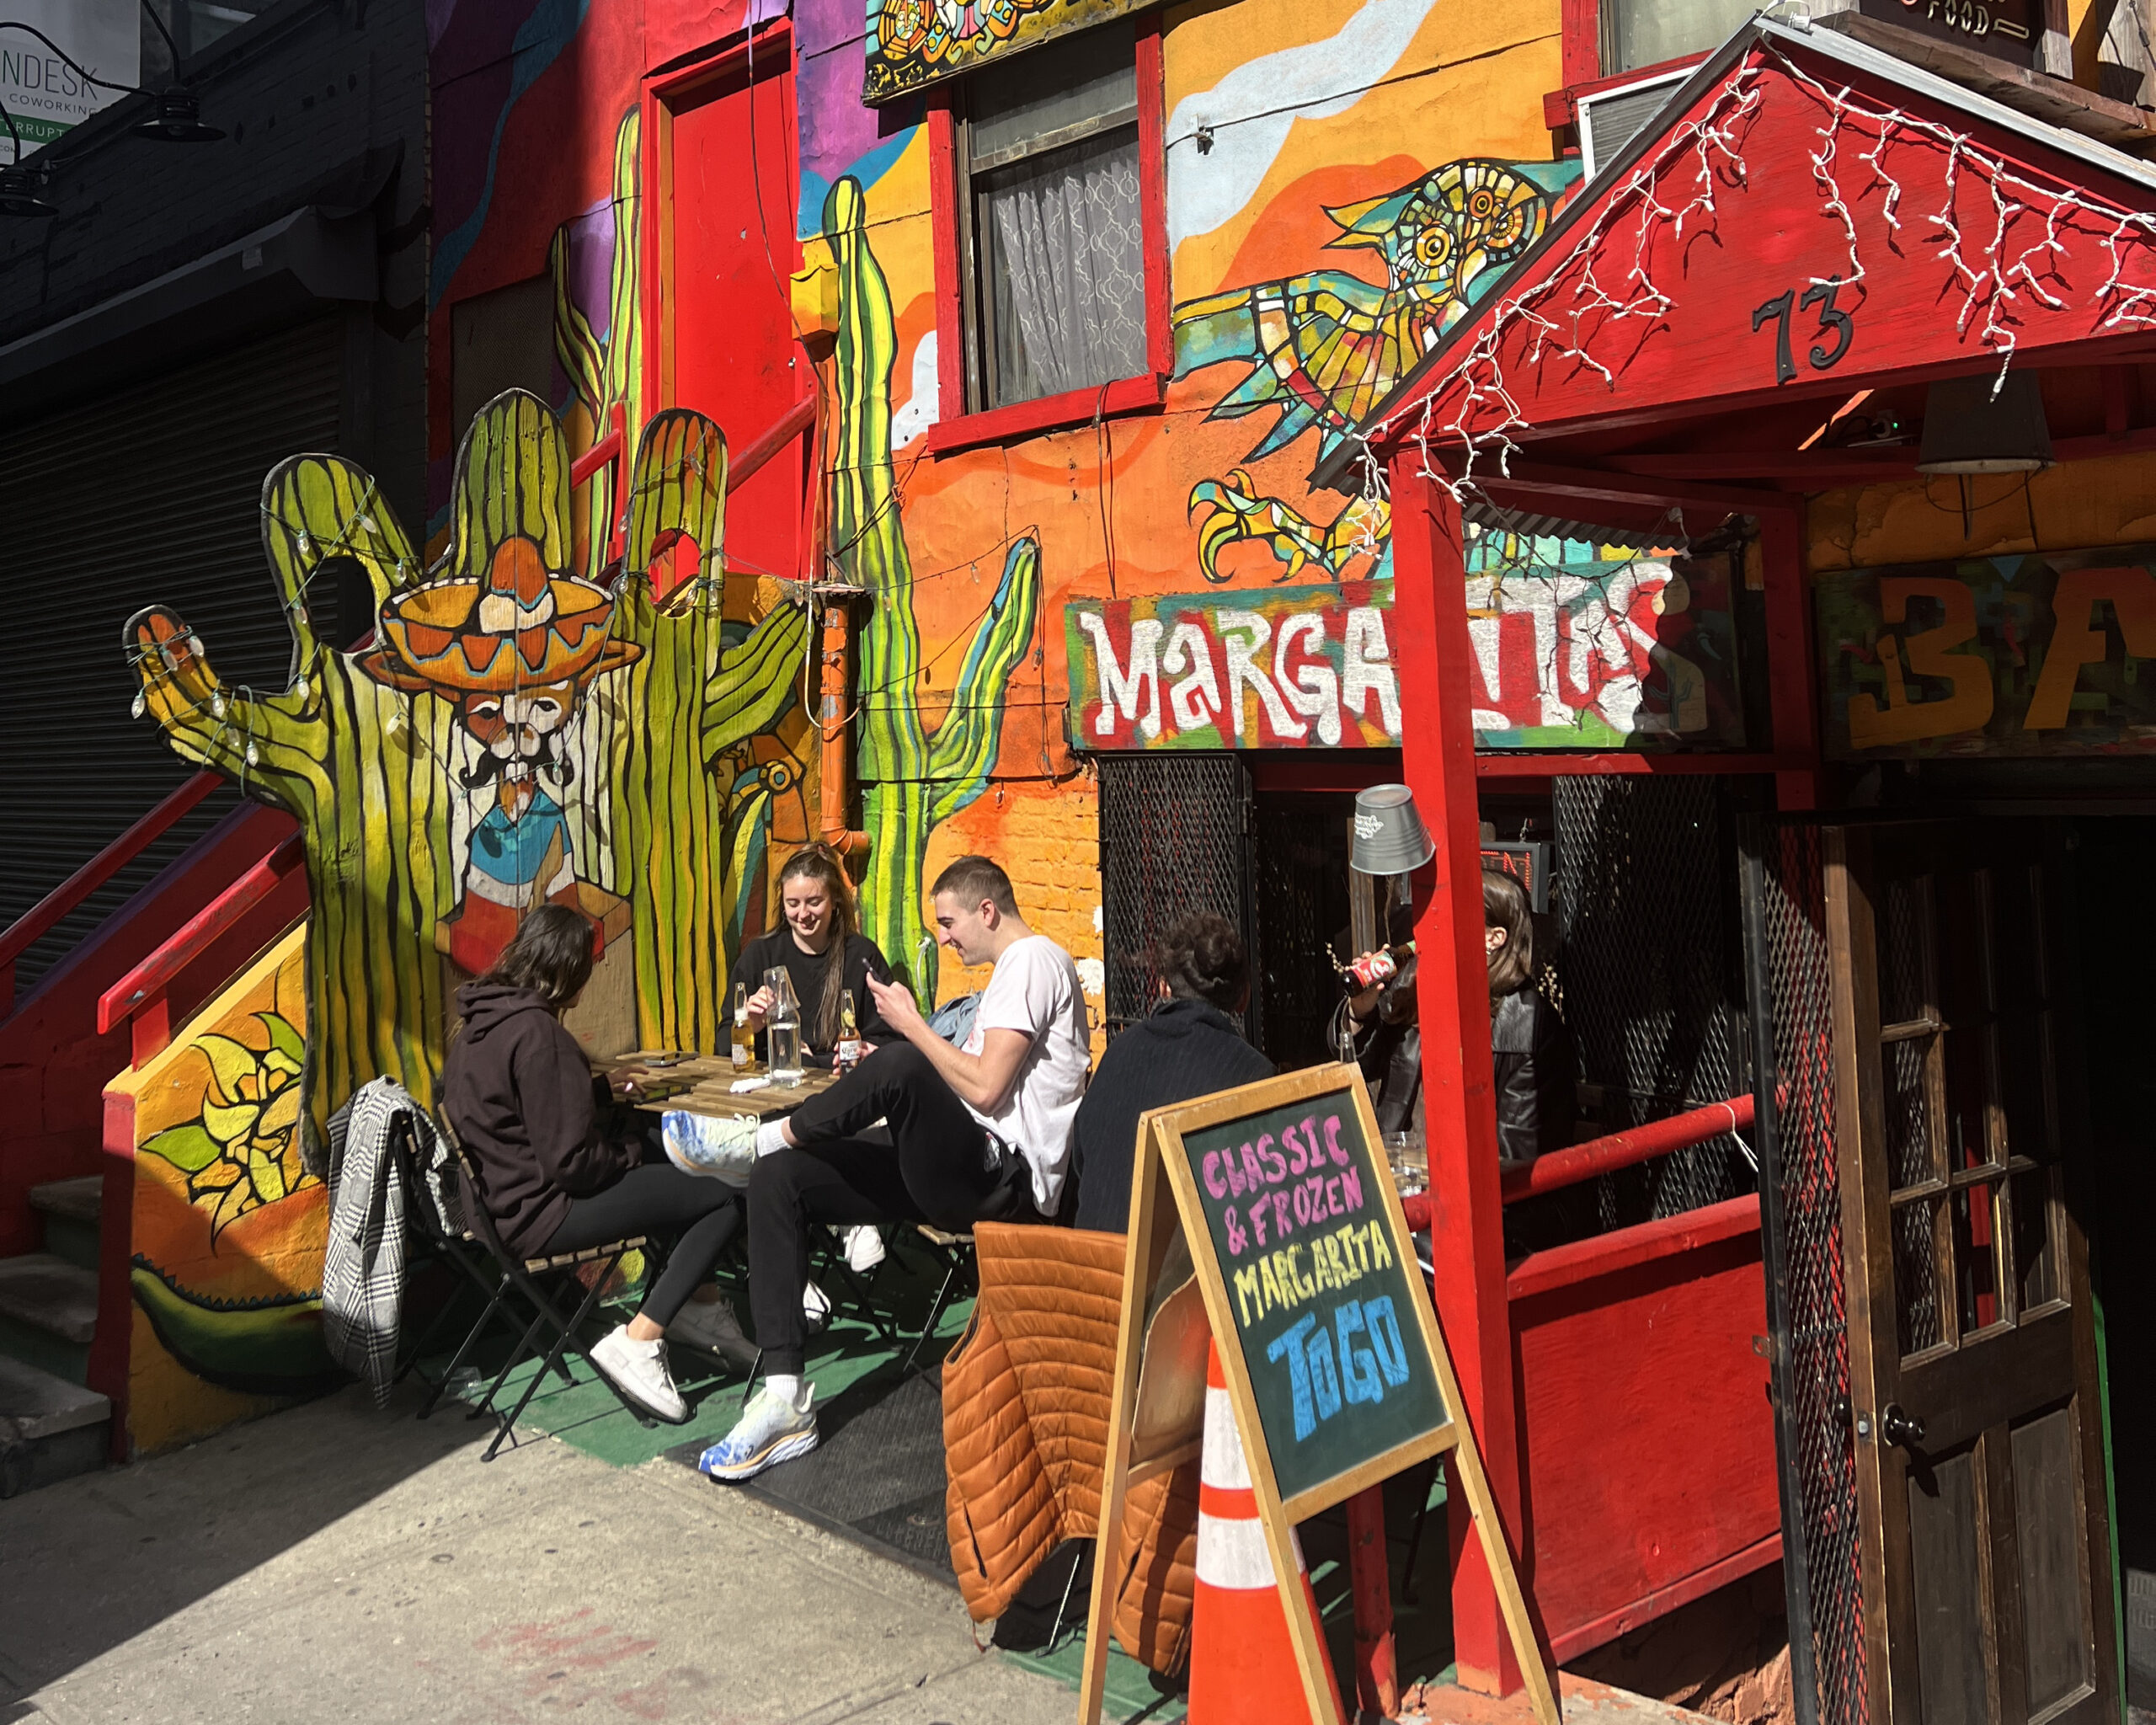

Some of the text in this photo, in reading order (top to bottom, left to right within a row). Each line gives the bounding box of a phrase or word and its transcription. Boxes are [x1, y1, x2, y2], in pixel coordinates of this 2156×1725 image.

[1752, 272, 1854, 385] 73
[1079, 562, 1708, 745] MARGAITAS
[1202, 1114, 1351, 1200] CLASSIC
[1233, 1219, 1394, 1327] MARGARITA
